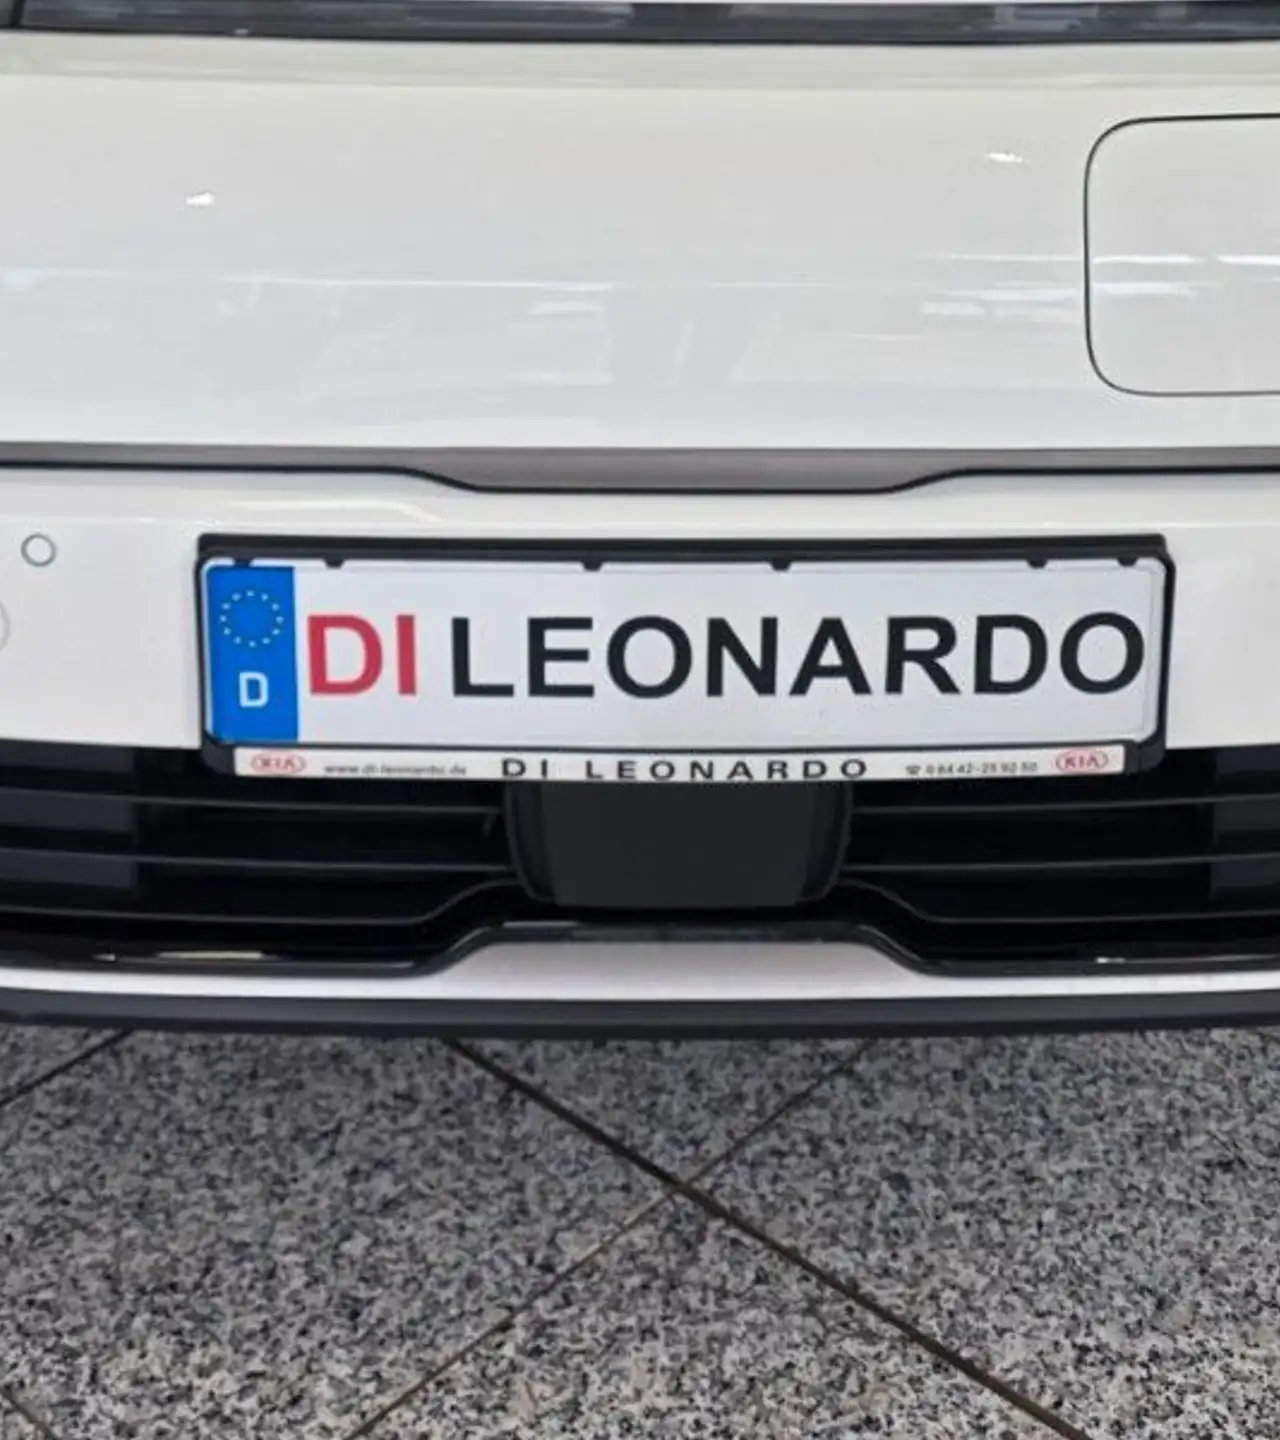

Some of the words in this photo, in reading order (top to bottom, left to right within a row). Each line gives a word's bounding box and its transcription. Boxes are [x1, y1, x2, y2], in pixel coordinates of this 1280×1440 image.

[307, 614, 417, 697] DI
[451, 612, 1145, 698] LEONARDO
[238, 671, 270, 708] D
[500, 758, 549, 778] DI
[584, 757, 867, 781] LEONARDO
[1063, 753, 1105, 770] KIA
